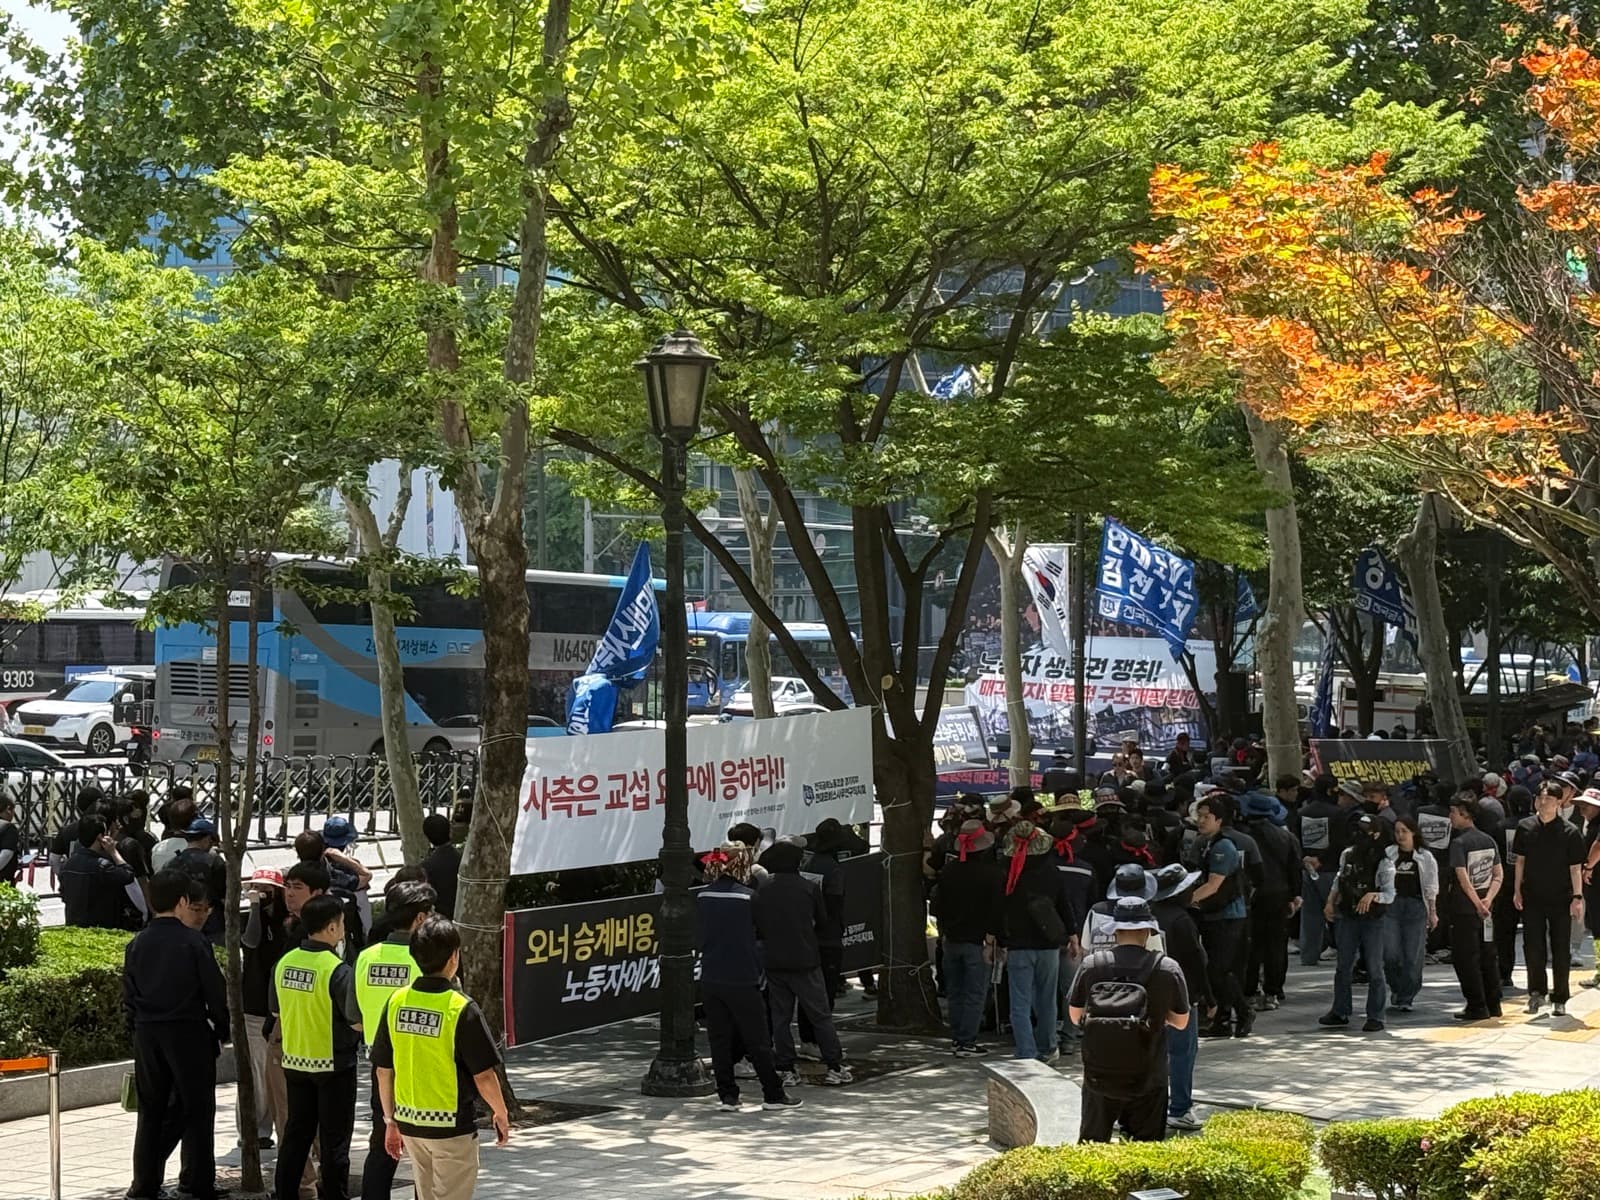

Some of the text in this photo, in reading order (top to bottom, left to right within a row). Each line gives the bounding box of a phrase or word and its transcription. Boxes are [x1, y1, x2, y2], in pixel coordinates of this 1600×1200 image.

[1111, 656, 1164, 683] 쟁취!
[3, 670, 35, 688] 9303
[523, 773, 601, 821] 사측은
[604, 768, 651, 812] 교섭
[719, 754, 786, 801] 응하라!!
[525, 912, 660, 965] 오너 승계비용,
[284, 967, 313, 984] 대화경찰
[370, 965, 408, 979] 대화경찰
[371, 977, 407, 985] POLICE
[561, 955, 661, 1003] 노동자에게
[283, 980, 313, 991] POLICE
[399, 1008, 440, 1027] 대화경찰
[399, 1023, 438, 1036] POLICE
